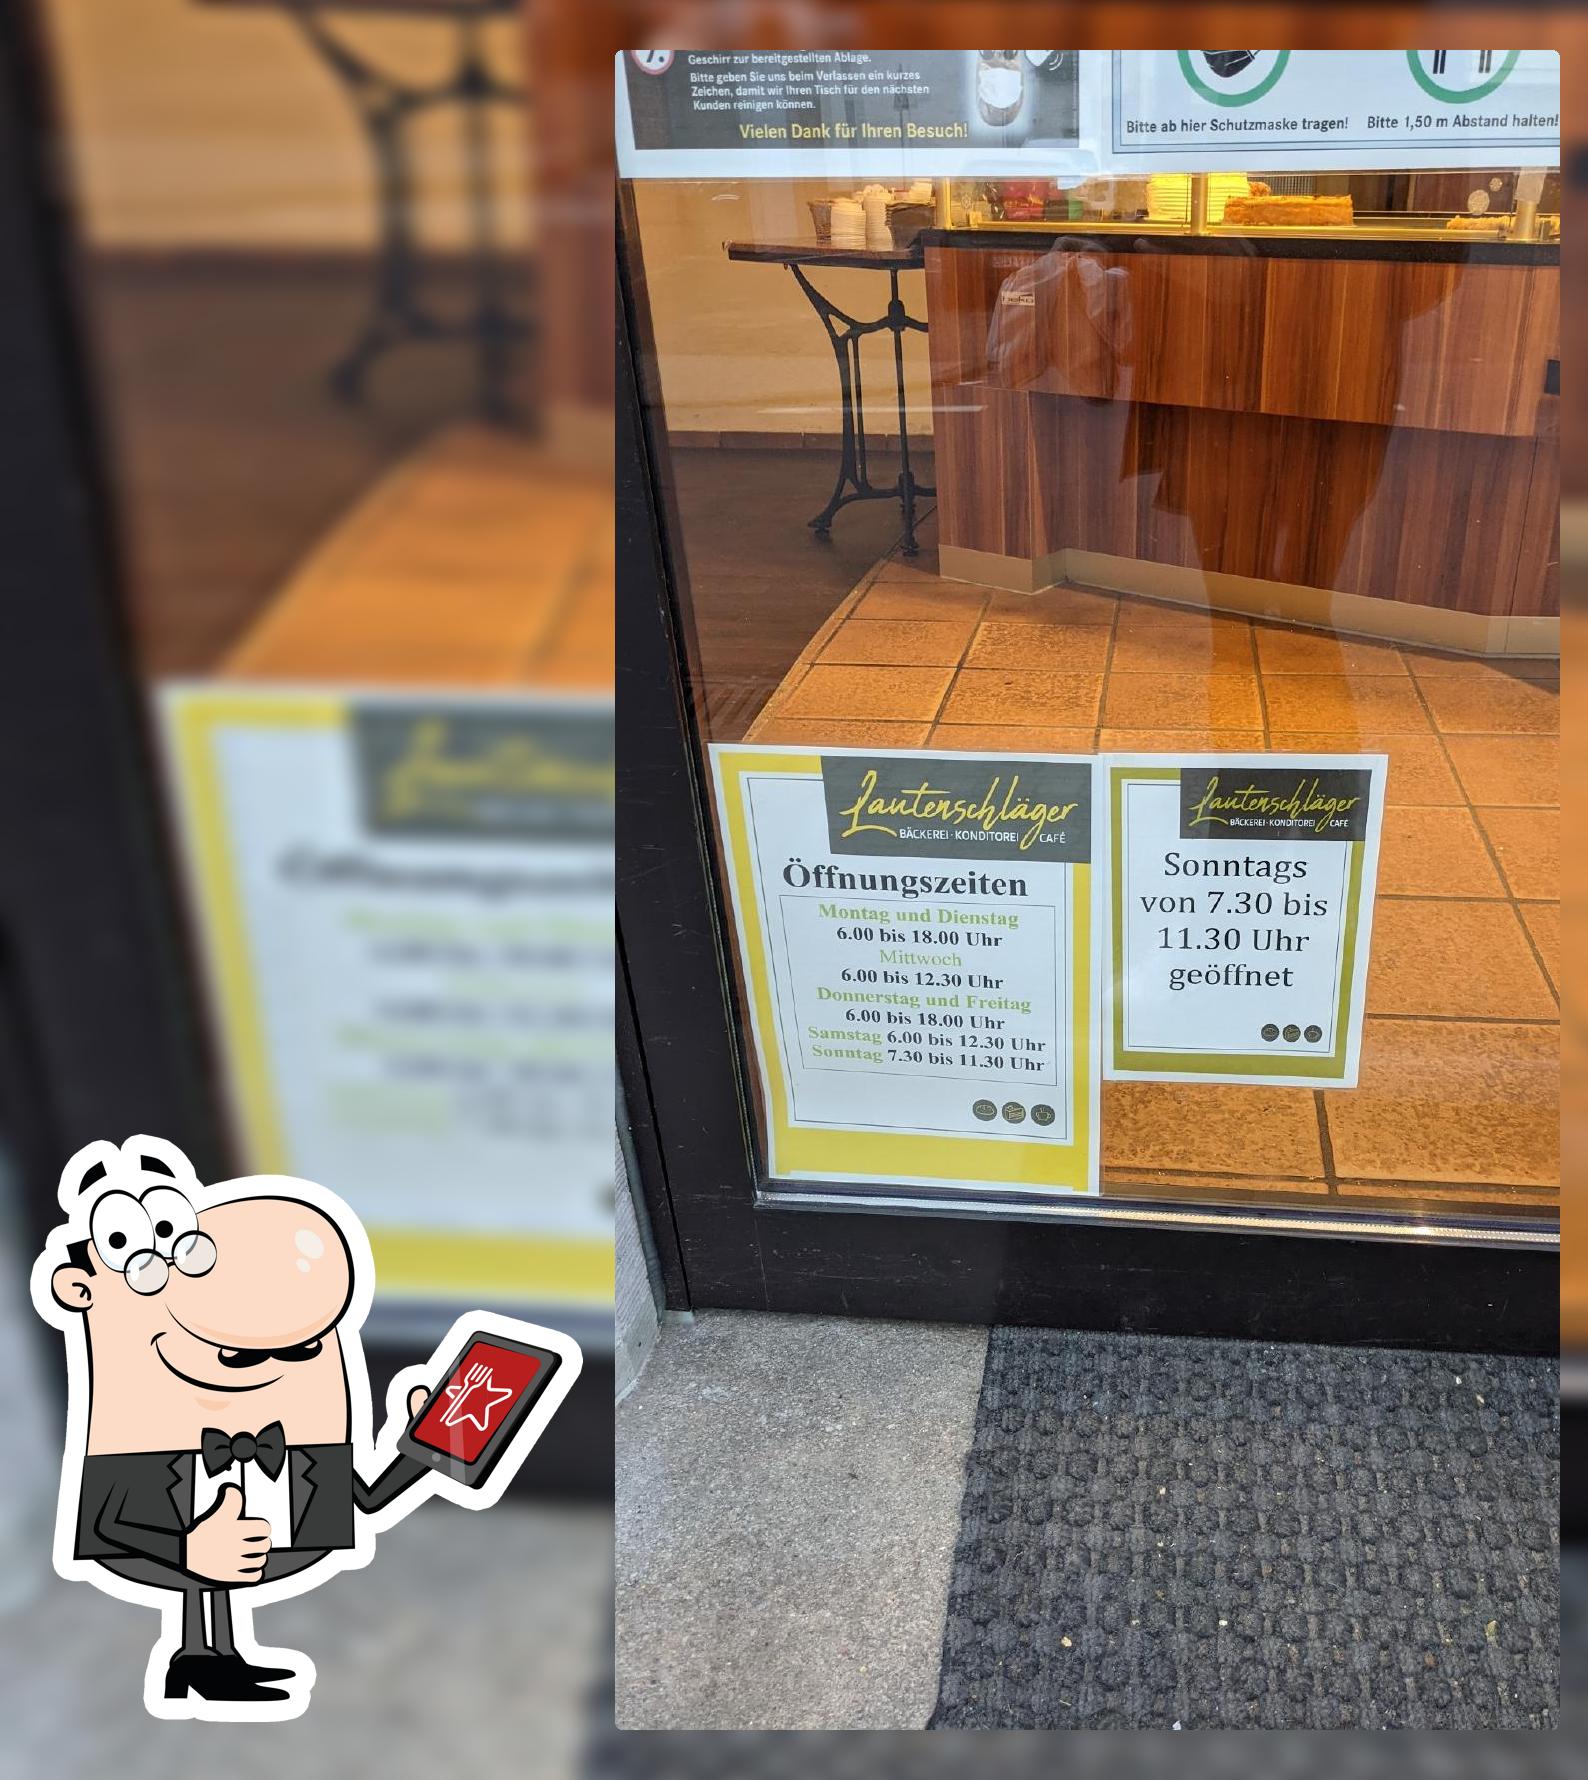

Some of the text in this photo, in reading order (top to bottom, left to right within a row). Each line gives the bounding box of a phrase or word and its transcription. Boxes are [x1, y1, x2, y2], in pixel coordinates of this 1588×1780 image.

[688, 51, 872, 66] Geschirr zur bereitgestellten Ablage.
[690, 70, 921, 85] Bitte geben Sie uns beim Verlassen ein kurzes
[691, 84, 930, 98] Zeichen, damit wir Ihren Tisch für den nächsten
[693, 99, 816, 112] Kunden reinigen können.
[739, 121, 969, 140] Vielen Dank für Ihren Besuch!
[1126, 116, 1349, 134] Bitte ab hier Schutzmaske tragen!
[1367, 113, 1560, 130] Bitte 1,50 m Abstand halten!
[839, 769, 1079, 850] Lautenschläger
[1188, 776, 1361, 832] Lautenschläger
[1039, 831, 1067, 844] CAFÉ
[782, 857, 1029, 898] Öffnungszeiten
[1163, 852, 1308, 884] Sonntags
[1139, 891, 1328, 916] von 7.30 bis
[818, 903, 1020, 929] Montag und Dienstag
[837, 927, 1003, 947] 6.00 bis 18.00 Uhr
[1157, 927, 1310, 952] 11.30 Uhr
[879, 949, 962, 967] Mittwoch
[841, 968, 1004, 990] 6.00 bis 12.30 Uhr
[1169, 963, 1294, 991] geöffnet
[816, 987, 1032, 1014] Donnerstag und Freitag
[845, 1008, 1006, 1030] 6.00 bis 18.00 Uhr
[807, 1025, 1047, 1052] Samstag 6.00 bis 12.30 Uhr
[811, 1045, 1046, 1072] Sonntag 7.30 bis 11.30 Uhr
